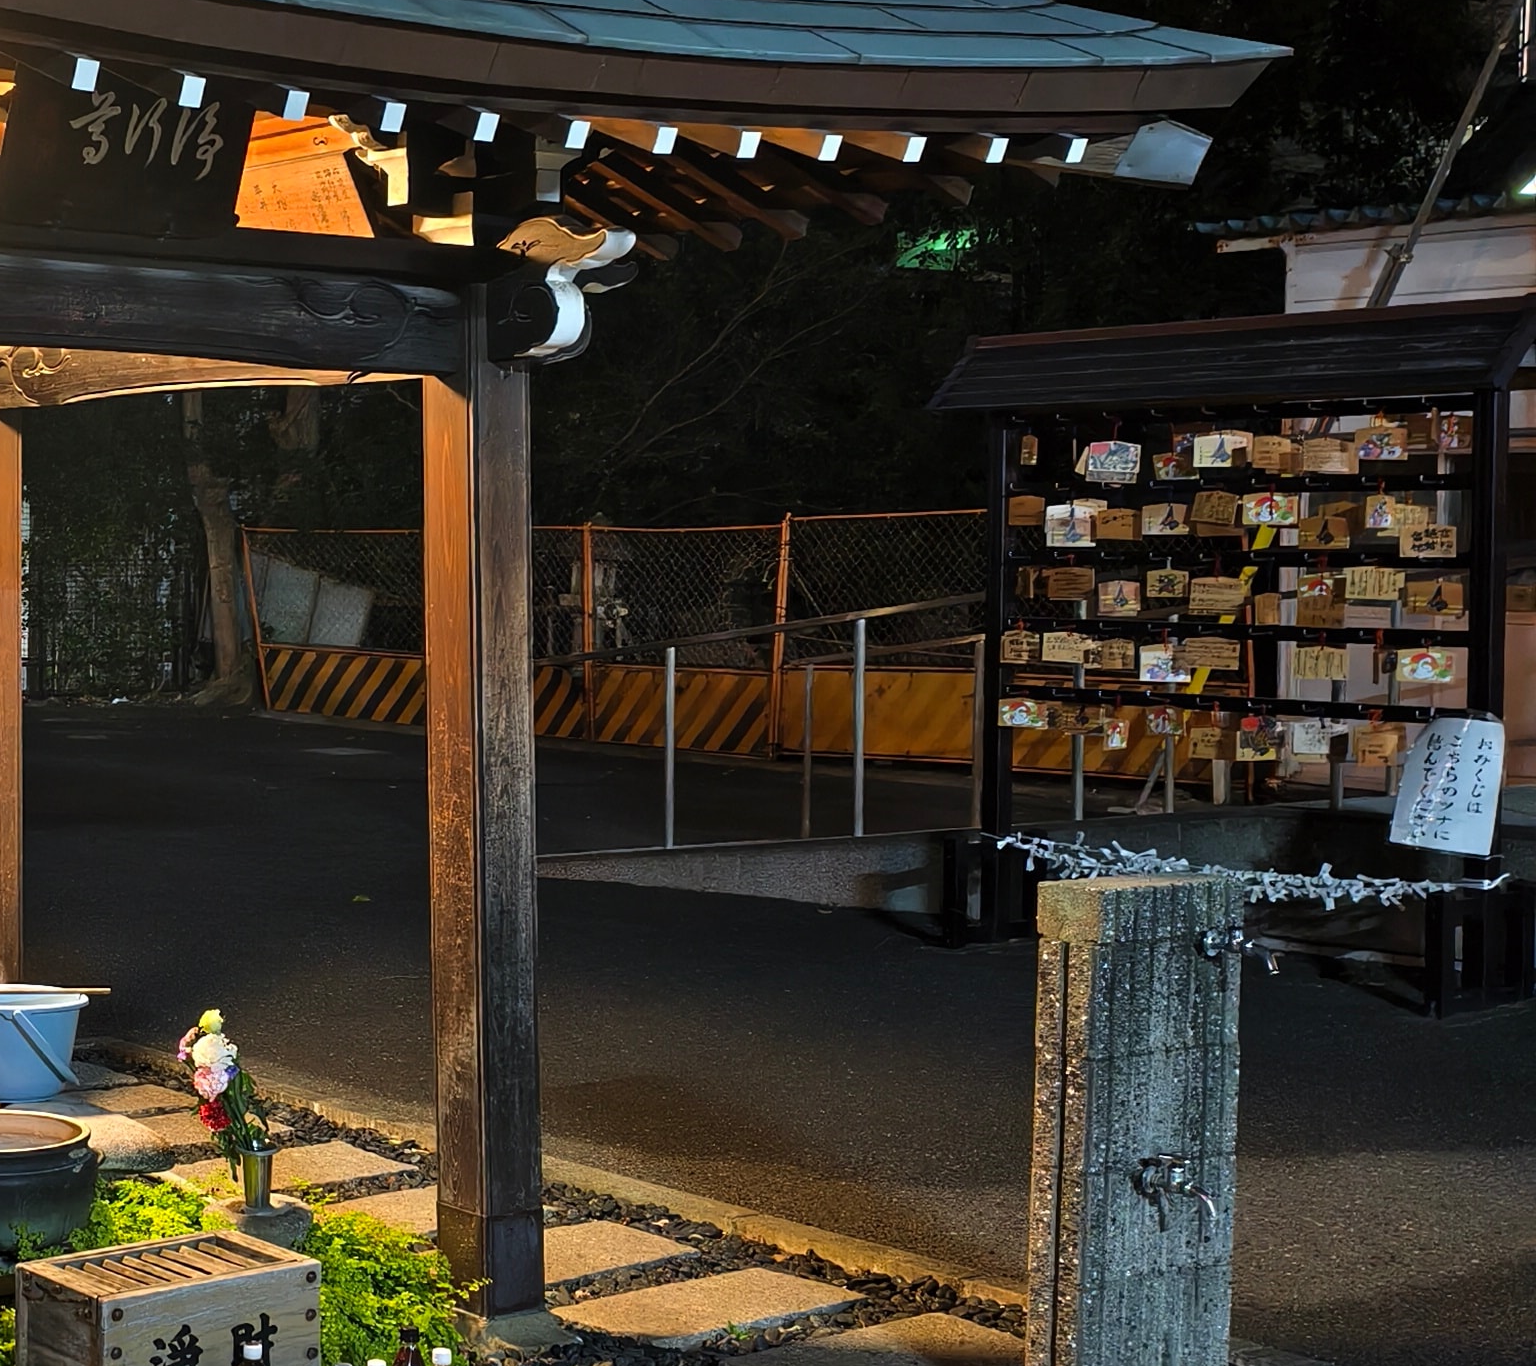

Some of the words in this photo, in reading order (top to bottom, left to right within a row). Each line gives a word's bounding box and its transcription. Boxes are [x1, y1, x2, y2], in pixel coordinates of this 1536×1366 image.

[1434, 734, 1463, 841] こちらのツナに
[1467, 737, 1493, 814] おみくじは
